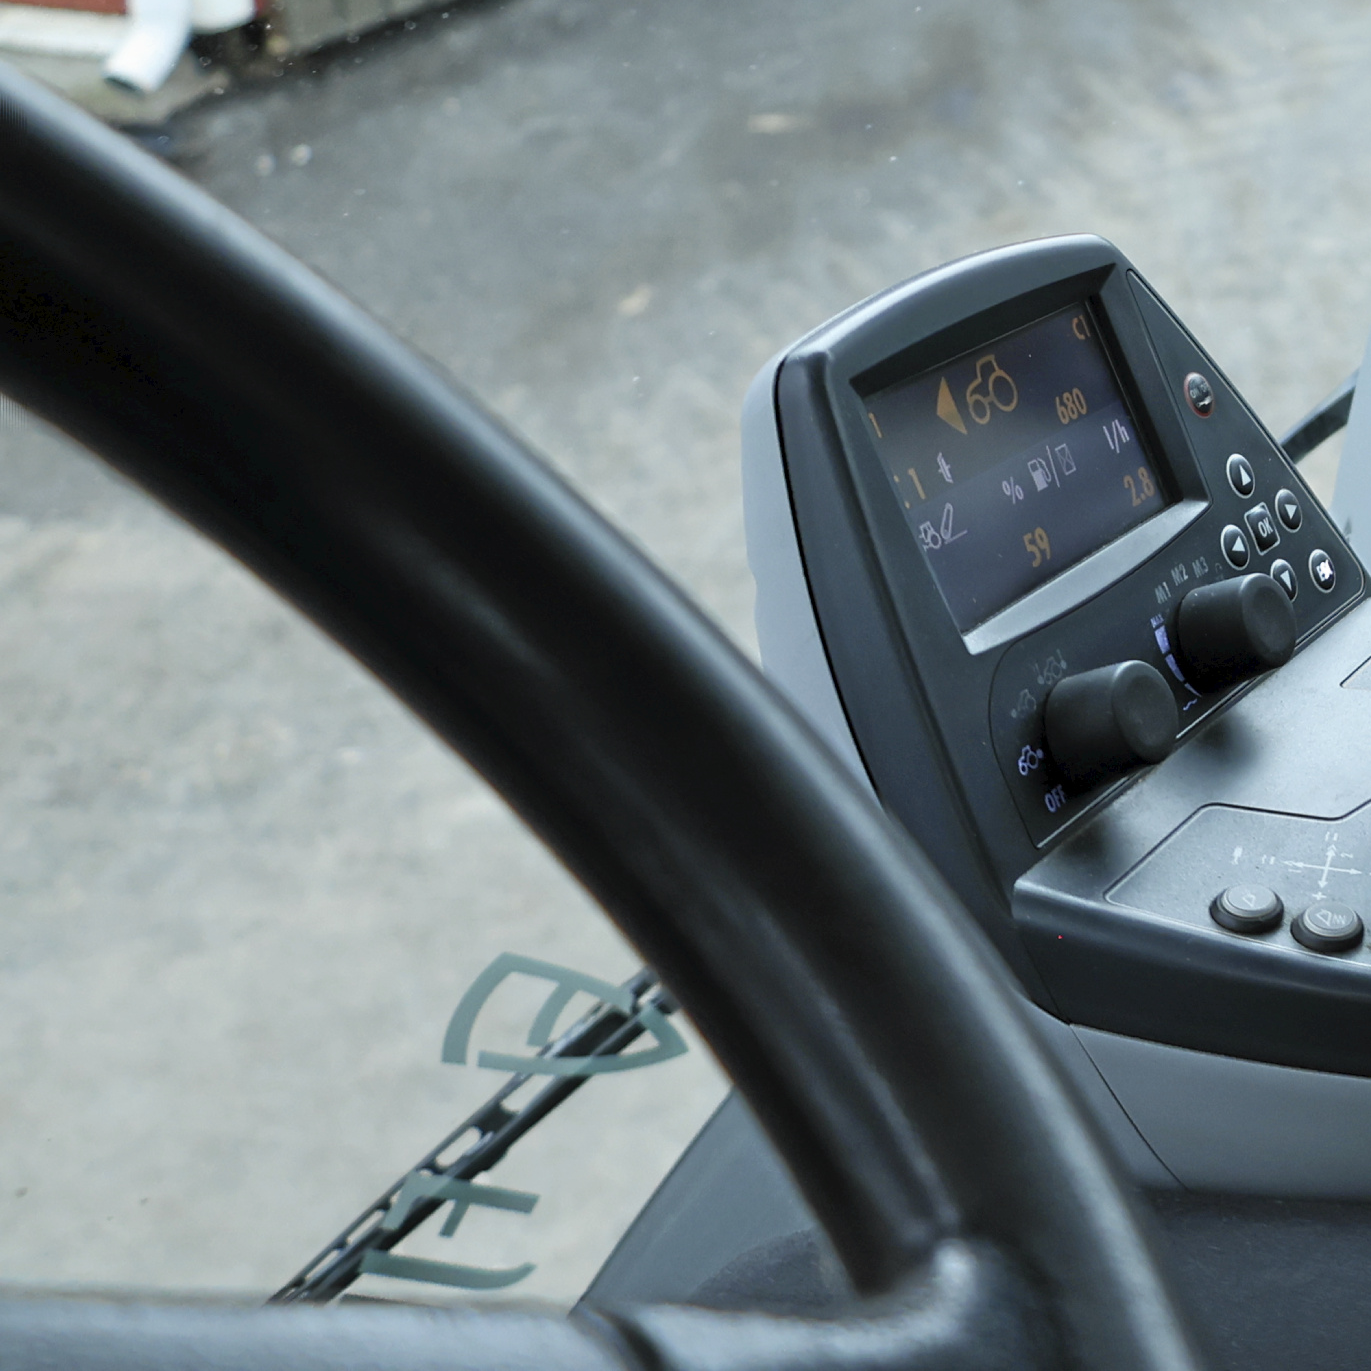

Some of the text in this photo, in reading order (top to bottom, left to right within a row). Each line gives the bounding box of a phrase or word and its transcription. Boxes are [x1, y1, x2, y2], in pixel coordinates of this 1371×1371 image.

[1055, 387, 1088, 425] 680
[1123, 466, 1156, 507] 2.8
[1257, 516, 1273, 538] OK
[1022, 526, 1050, 568] 59
[1170, 563, 1189, 587] M2
[1191, 556, 1209, 579] M3
[1154, 581, 1172, 605] M1
[1044, 784, 1066, 813] OFF
